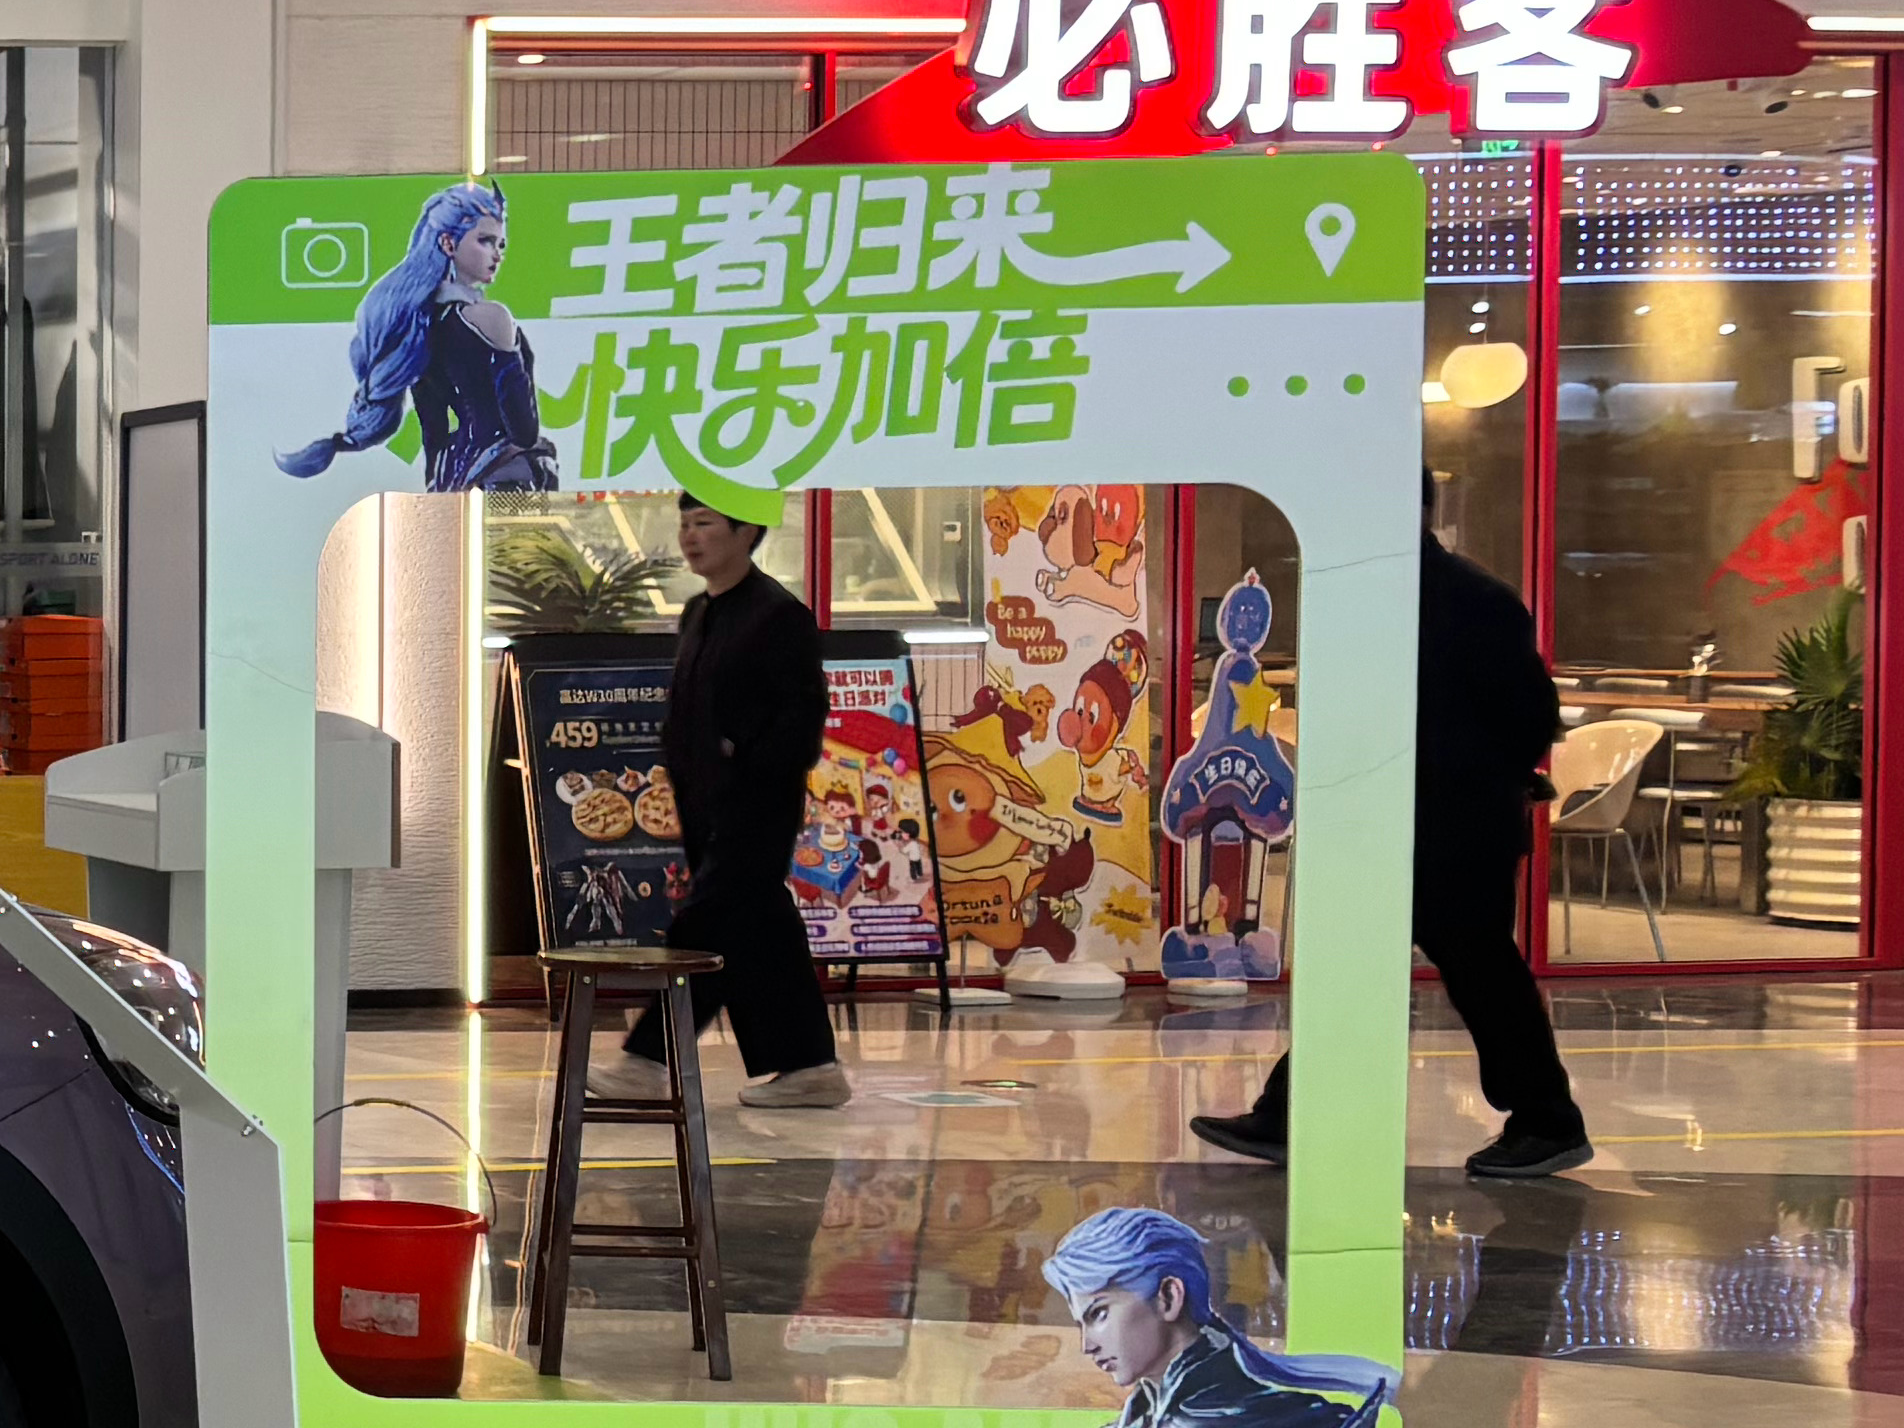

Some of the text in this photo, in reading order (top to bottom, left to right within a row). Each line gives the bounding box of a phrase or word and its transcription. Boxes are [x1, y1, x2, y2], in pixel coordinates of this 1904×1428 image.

[551, 161, 1059, 319] 王者归来
[566, 310, 1091, 492] 快乐加倍
